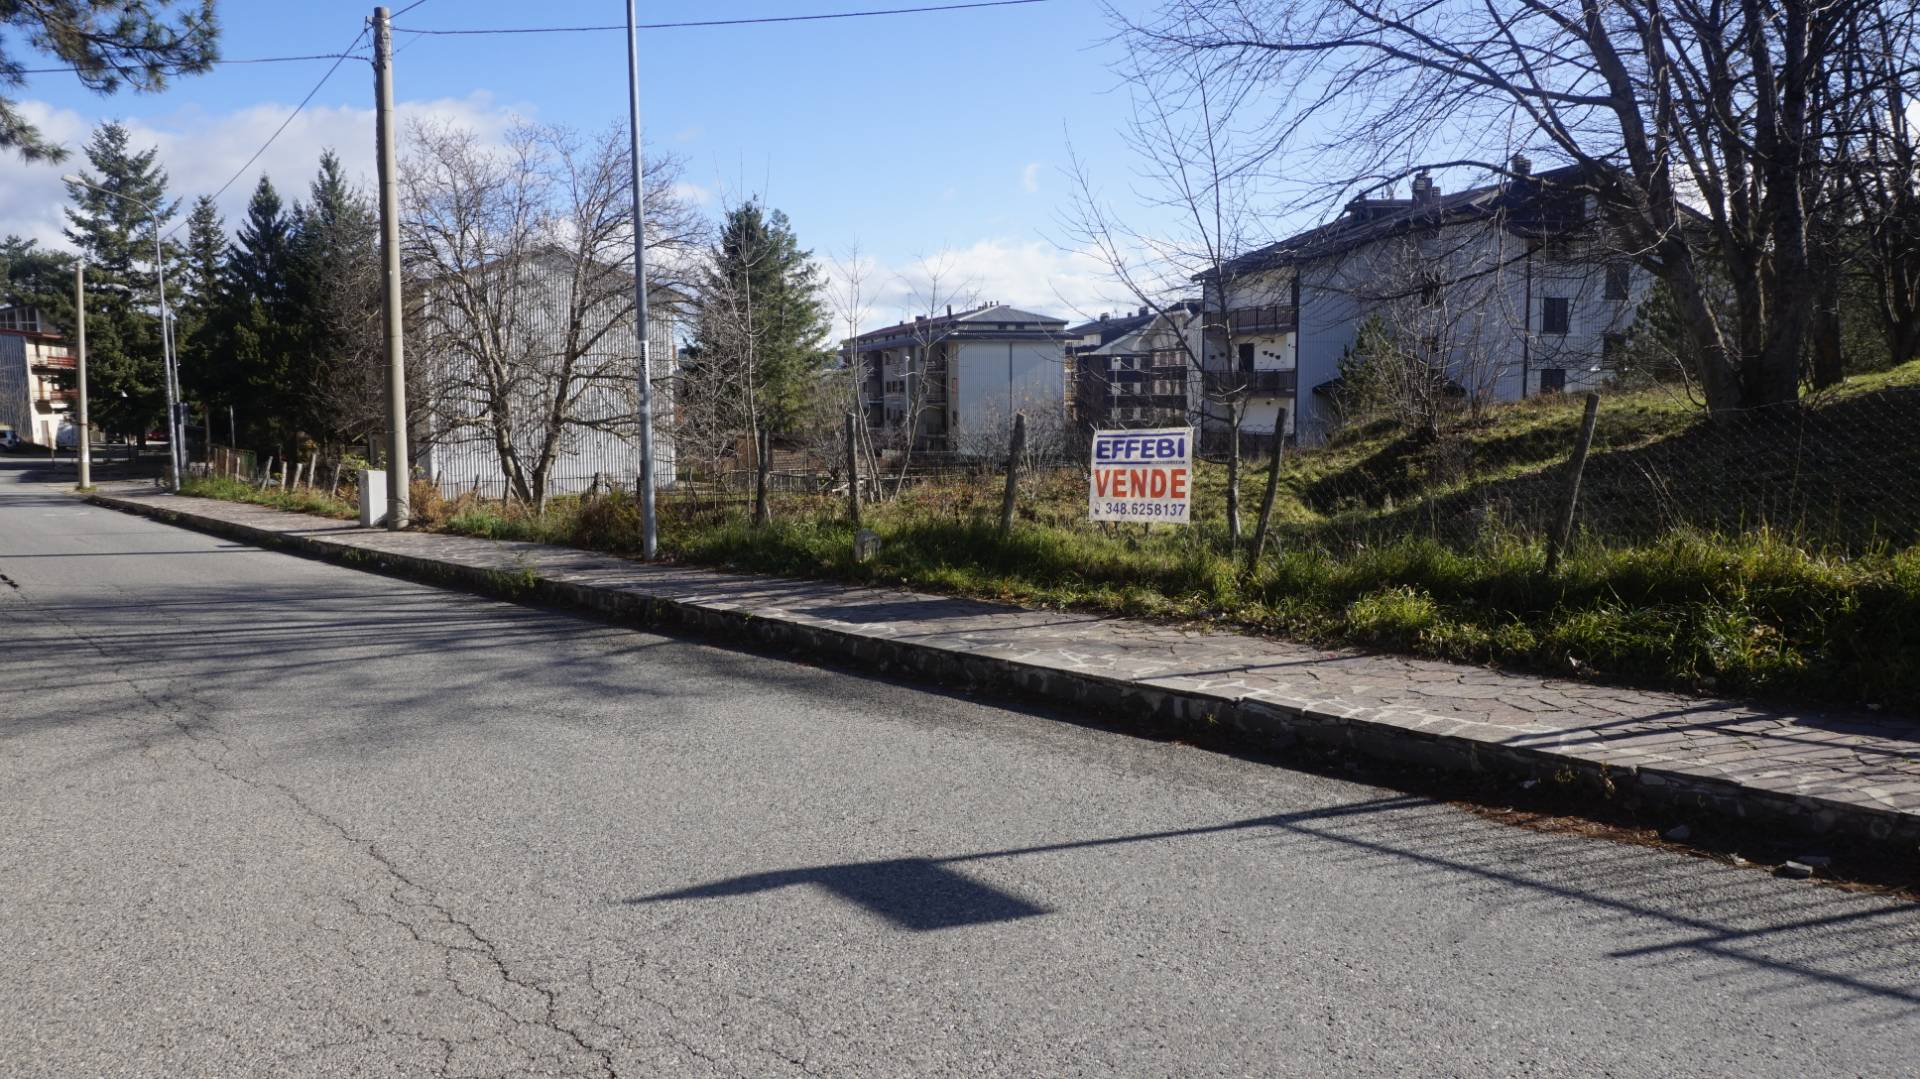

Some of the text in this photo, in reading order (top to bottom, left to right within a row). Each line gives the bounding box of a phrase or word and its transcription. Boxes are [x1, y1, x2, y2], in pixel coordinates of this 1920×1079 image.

[1096, 438, 1185, 459] EFFEBI
[1095, 469, 1186, 498] VENDE
[1105, 502, 1186, 516] 348.6258137
